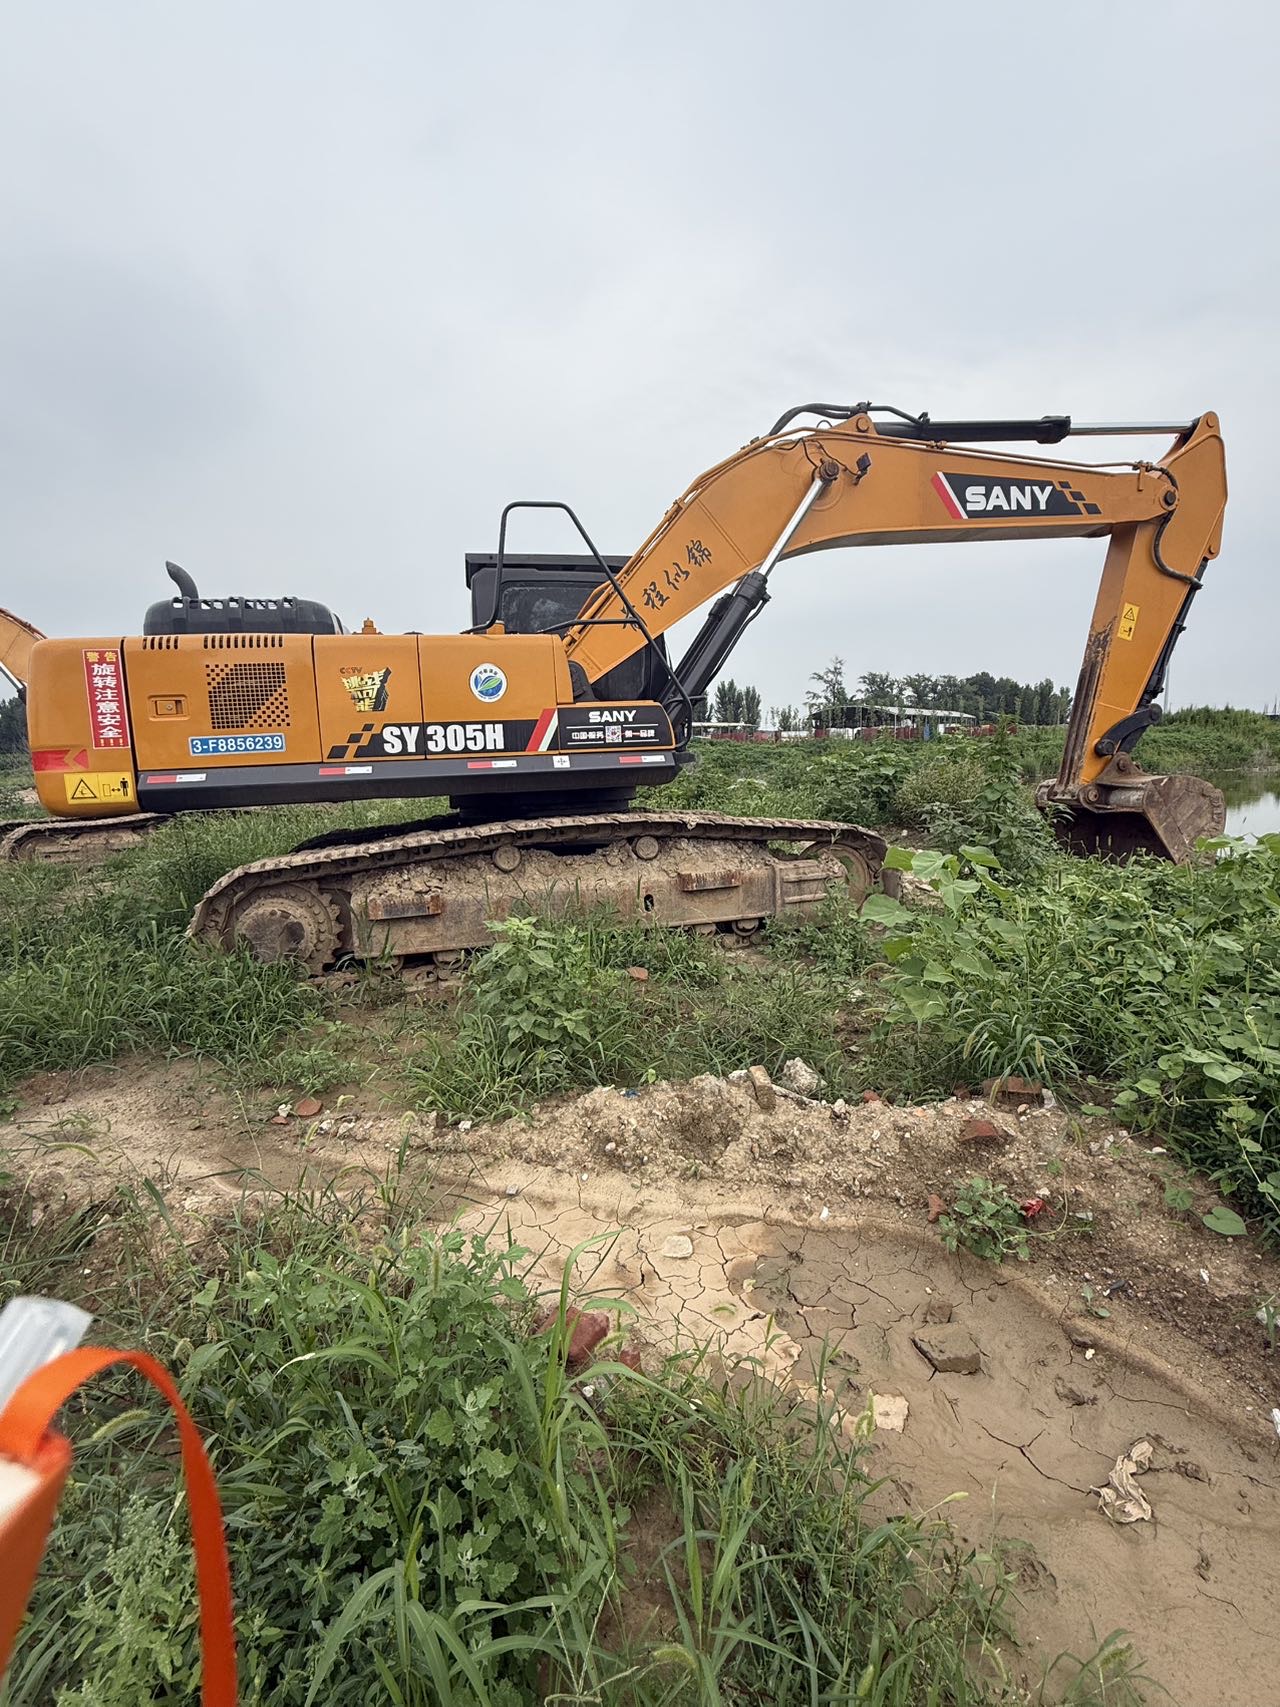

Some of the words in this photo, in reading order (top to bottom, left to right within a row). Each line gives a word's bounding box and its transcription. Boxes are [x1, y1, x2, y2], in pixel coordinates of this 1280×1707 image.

[965, 485, 1053, 511] SANY
[86, 651, 117, 663] 警告
[91, 663, 122, 738] 旋转注意安全
[588, 709, 637, 723] SANY
[192, 735, 283, 753] 3-F8856239
[382, 726, 420, 754] SY
[426, 723, 505, 752] 305H
